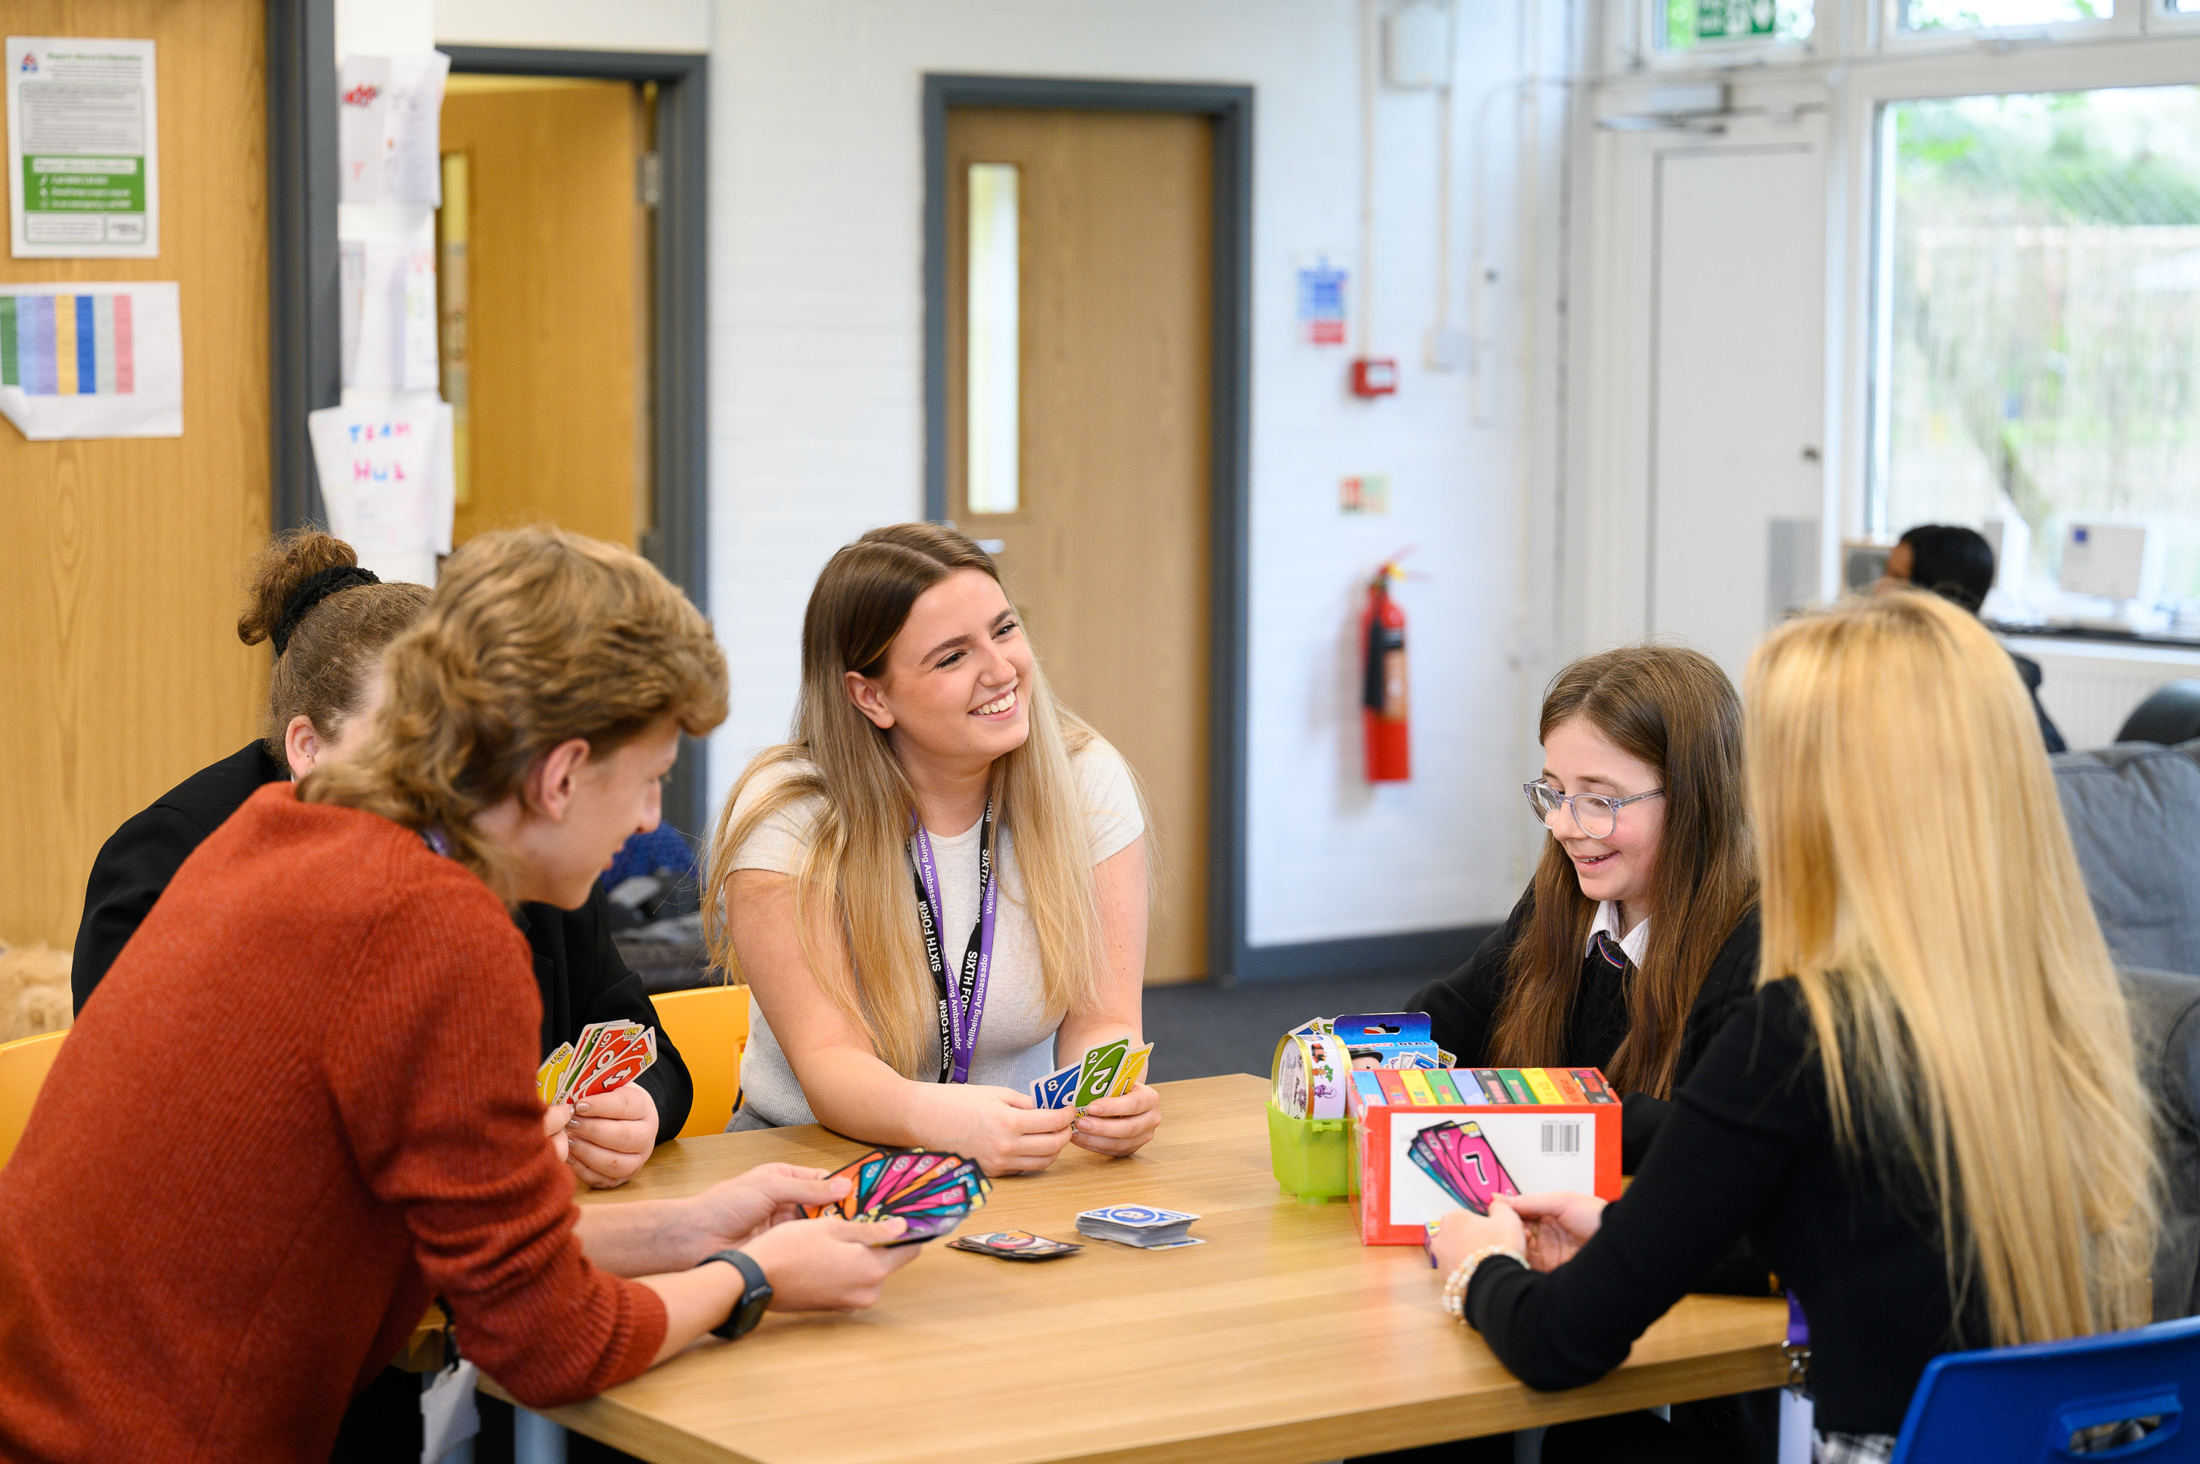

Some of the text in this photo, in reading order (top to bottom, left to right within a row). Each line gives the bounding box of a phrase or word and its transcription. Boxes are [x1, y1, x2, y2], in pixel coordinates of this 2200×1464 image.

[347, 422, 411, 443] TEAM
[924, 864, 939, 918] Ambassador
[918, 901, 942, 972] SIXTH FORM
[963, 951, 978, 985] SIXTH
[939, 999, 949, 1034] FORM
[966, 953, 988, 1049] Wellbeing Ambassador
[951, 999, 962, 1050] Ambassador
[550, 1045, 568, 1064] UNO
[1087, 1051, 1099, 1065] 2
[1047, 1079, 1059, 1092] 8
[1090, 1066, 1114, 1095] 2
[1438, 1131, 1453, 1150] 7
[1461, 1151, 1490, 1185] 7
